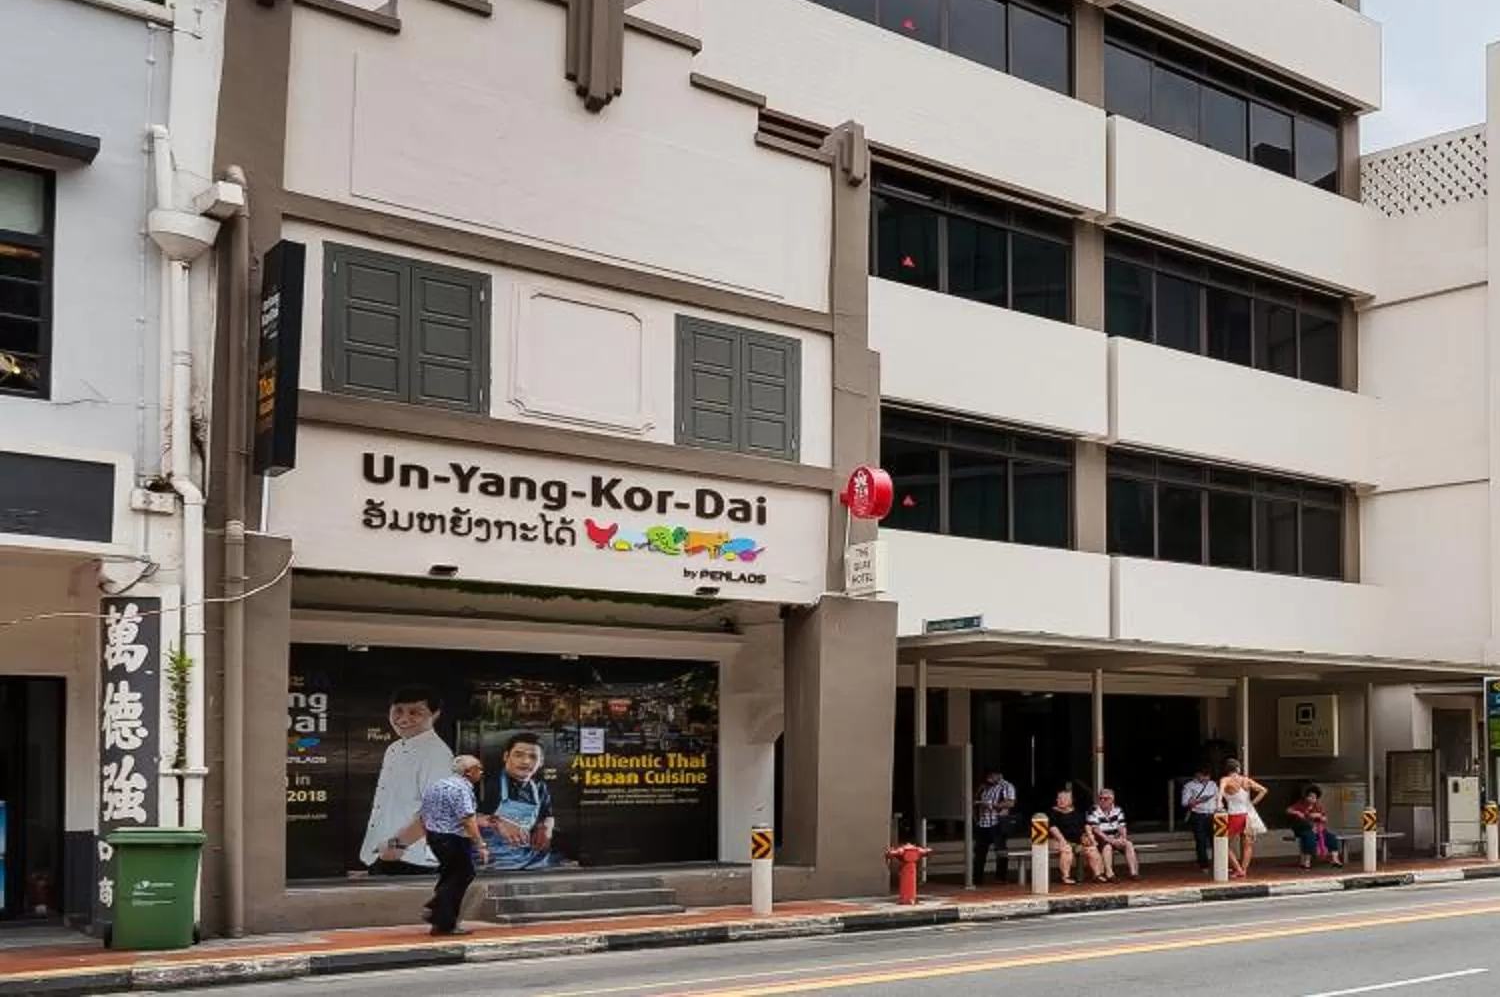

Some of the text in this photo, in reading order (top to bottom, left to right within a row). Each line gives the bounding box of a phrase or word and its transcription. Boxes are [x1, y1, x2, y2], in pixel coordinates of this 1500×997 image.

[362, 452, 767, 526] Un-Yang-Kor-Dai
[683, 568, 699, 579] by
[102, 603, 149, 823] 萬德強
[571, 752, 707, 768] Authentic Thai
[295, 772, 312, 786] in
[584, 769, 639, 785] Isaan
[644, 769, 708, 784] Cuisine
[287, 789, 328, 802] 2018
